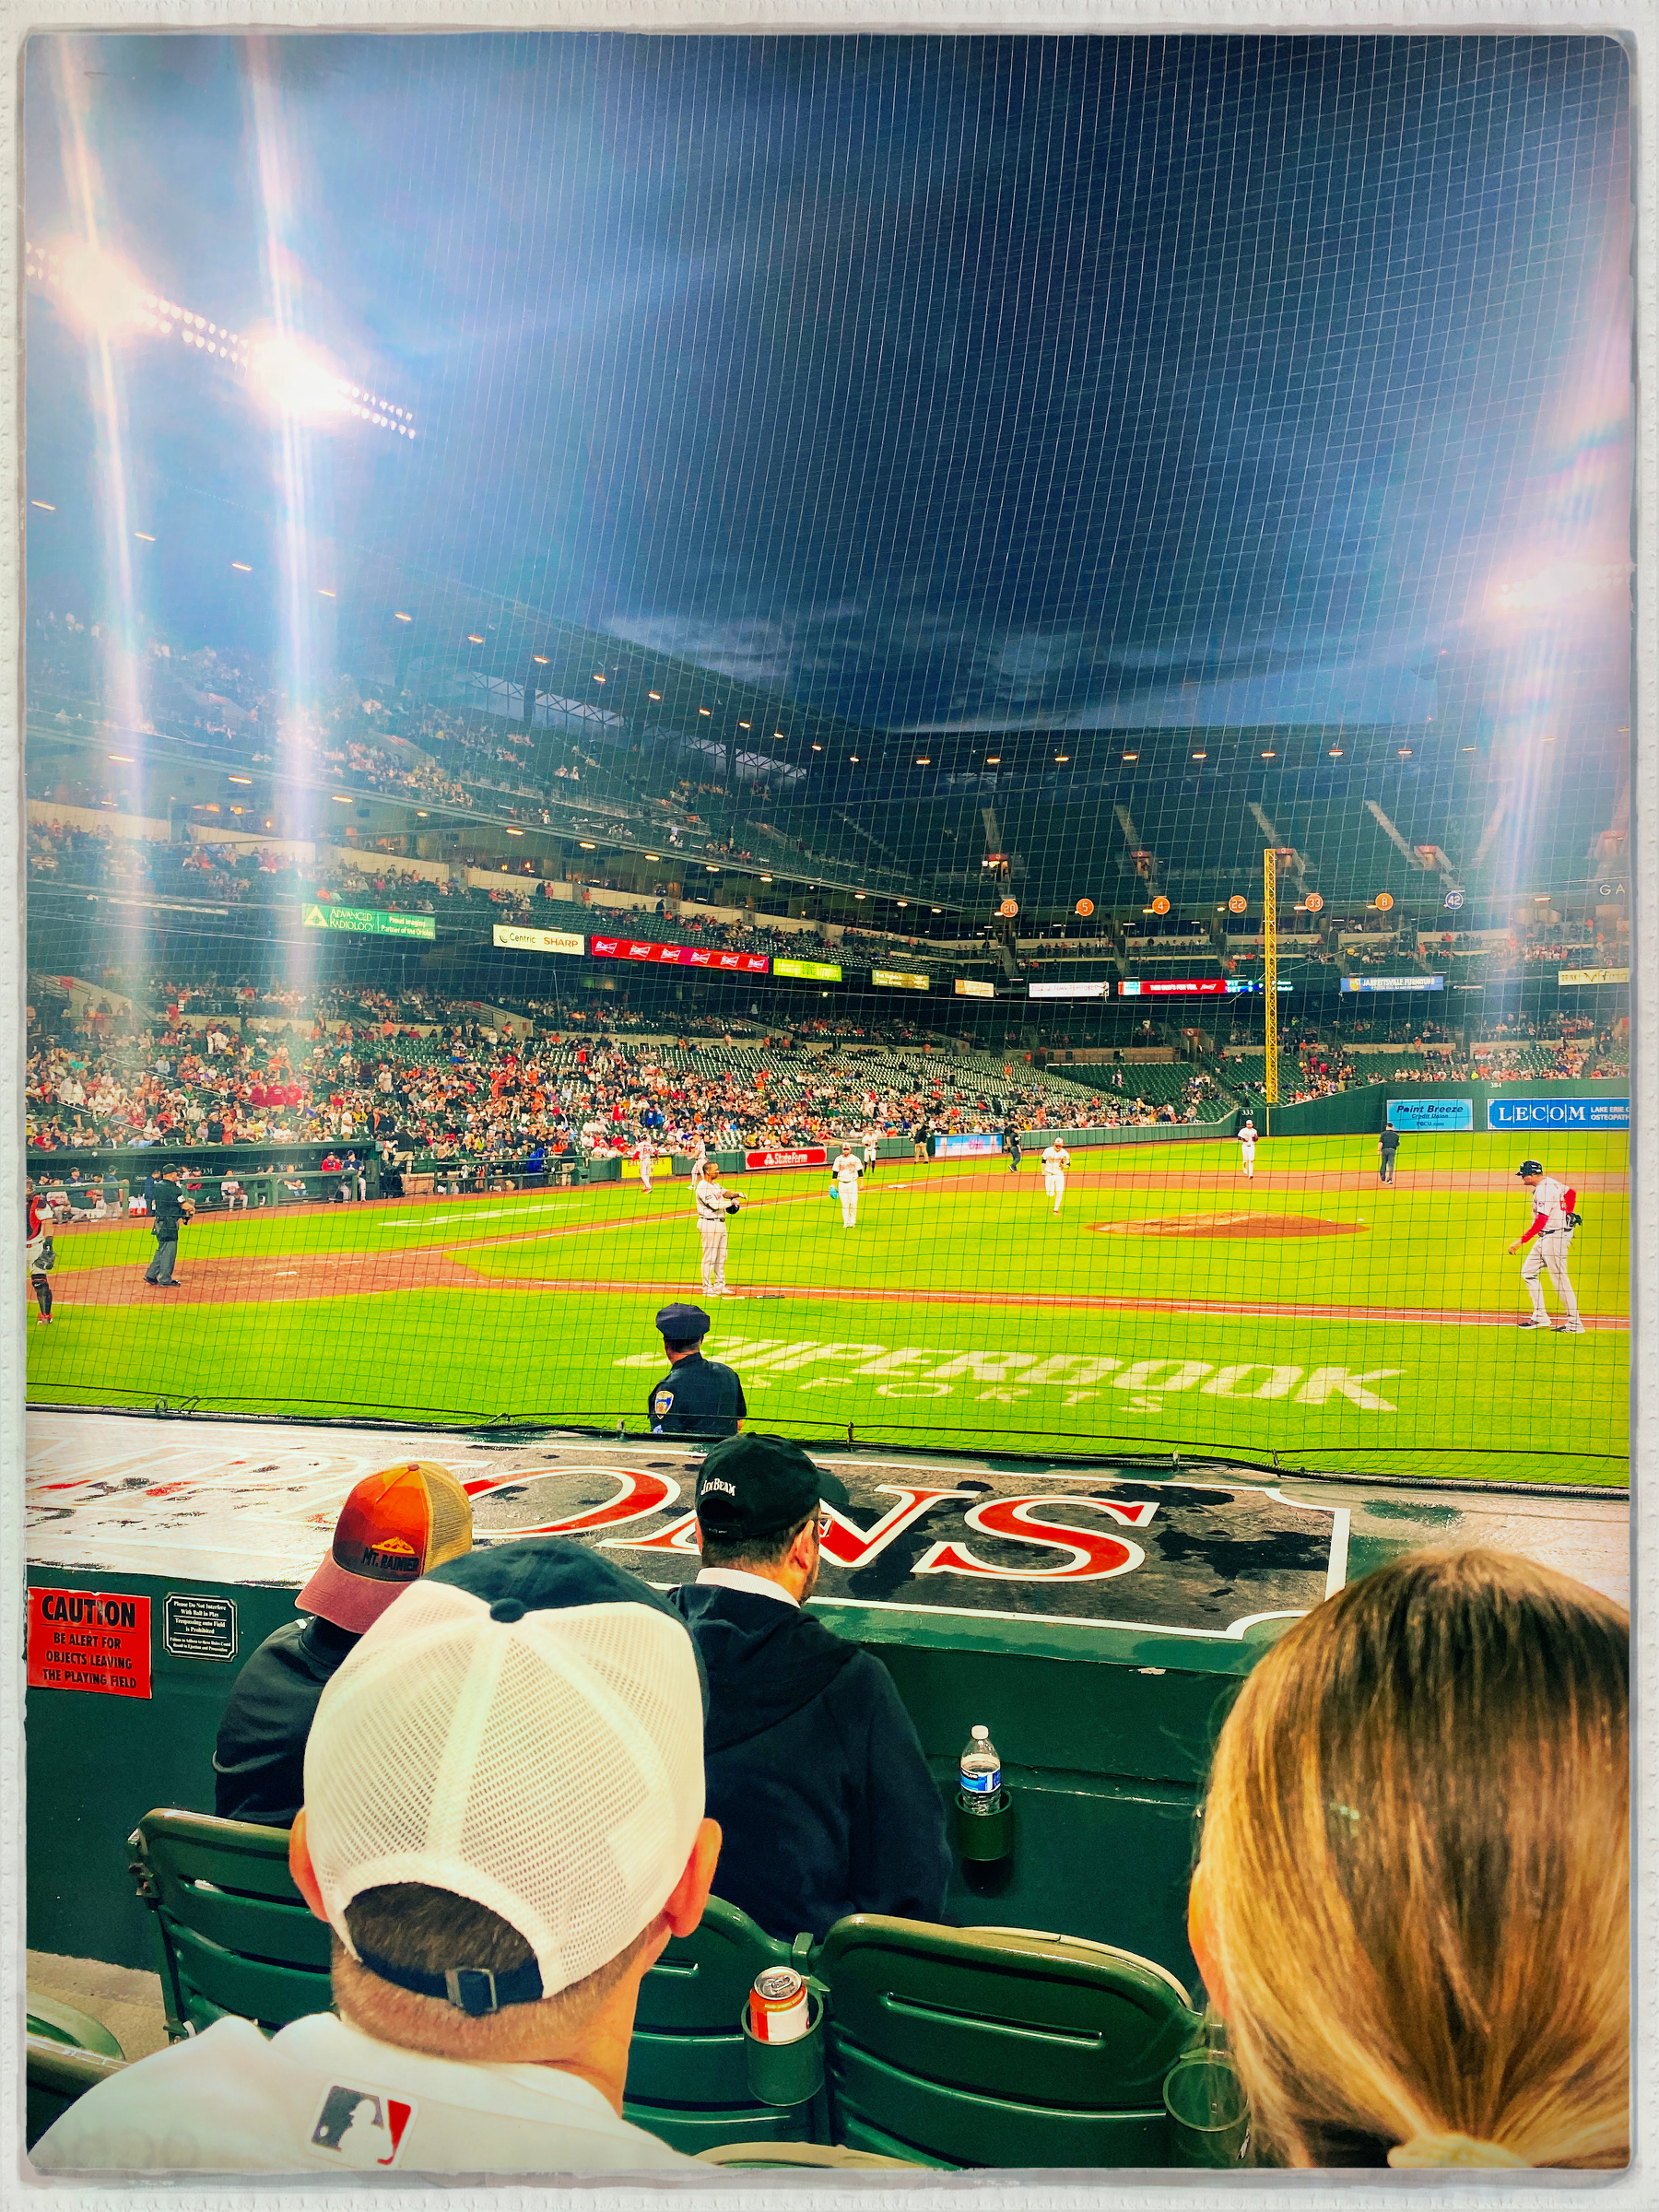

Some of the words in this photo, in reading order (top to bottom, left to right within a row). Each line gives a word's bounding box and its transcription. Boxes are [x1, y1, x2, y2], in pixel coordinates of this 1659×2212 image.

[1231, 899, 1244, 909] 22
[1308, 898, 1321, 908] 33
[1447, 896, 1461, 906] 42
[1004, 903, 1016, 913] 20
[332, 908, 372, 921] ADVANCED
[389, 916, 405, 924] Proud
[330, 916, 375, 932] RADIOLOGY
[381, 925, 400, 934] Partner
[509, 933, 536, 944] Centric
[543, 936, 579, 947] SHARP
[1404, 978, 1435, 986] FURNITURE
[1427, 1105, 1464, 1113] Breeze
[713, 1477, 736, 1497] BEAM
[361, 1547, 380, 1567] MT.
[41, 1595, 135, 1628] CAUTION
[53, 1632, 65, 1644] BE
[69, 1633, 99, 1648] ALERT
[101, 1637, 121, 1650] FOR
[46, 1650, 88, 1665] OBJECTS
[90, 1654, 133, 1670] LEAVING
[42, 1668, 62, 1681] THE
[65, 1670, 107, 1686] PLAYING
[111, 1676, 136, 1688] FIELD
